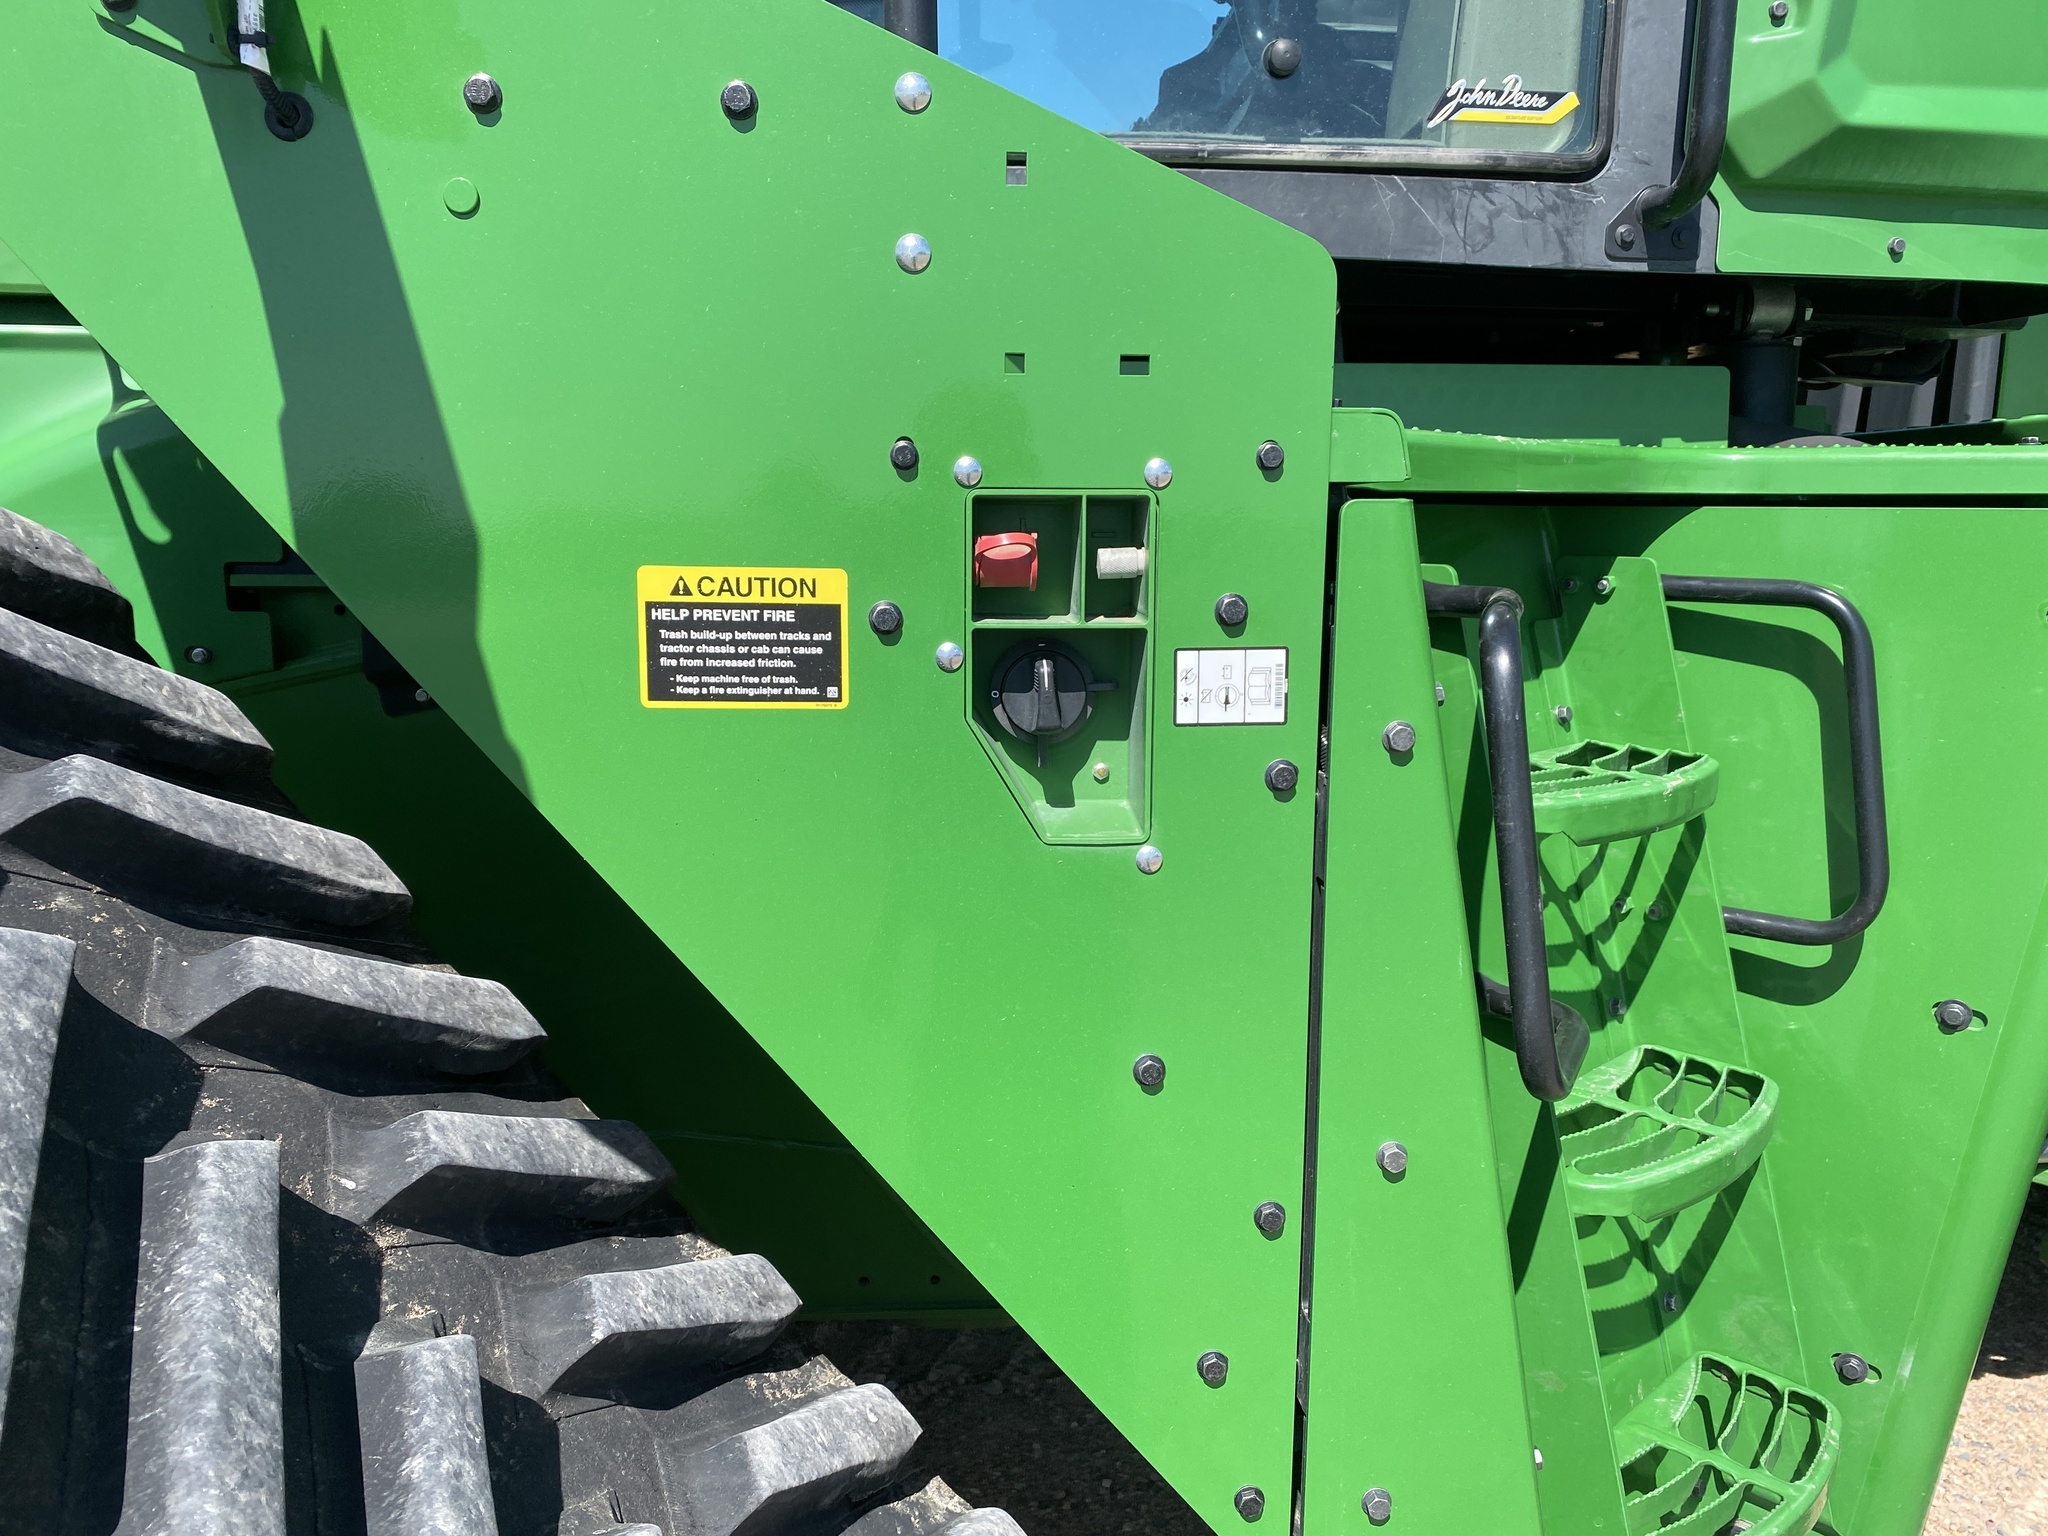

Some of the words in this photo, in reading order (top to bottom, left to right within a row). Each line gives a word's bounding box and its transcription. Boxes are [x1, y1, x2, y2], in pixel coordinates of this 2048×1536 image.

[1426, 78, 1498, 129] John
[1494, 74, 1549, 109] Deere
[697, 576, 816, 598] CAUTION
[651, 608, 690, 621] HELP
[693, 609, 761, 622] PREVENT
[763, 610, 796, 622] FIRE
[659, 629, 689, 640] Trash
[690, 630, 733, 642] build-up
[735, 631, 778, 641] between
[779, 631, 811, 641] tracks
[813, 632, 832, 641] and
[660, 644, 695, 654] tractor
[696, 644, 736, 654] chassis
[738, 646, 750, 654] or
[751, 645, 771, 654] cab
[772, 646, 791, 655] can
[793, 647, 824, 655] cause
[660, 657, 678, 667] fire
[679, 657, 704, 667] from
[706, 658, 756, 668] increased
[757, 658, 797, 668] friction.
[676, 674, 701, 685] Keep
[701, 675, 740, 684] machine
[741, 675, 760, 684] free
[761, 675, 772, 684] of
[772, 675, 799, 684] trash.
[676, 686, 701, 696] Keep
[702, 687, 708, 695] a
[709, 686, 725, 695] fire
[726, 686, 783, 698] extinguisher
[784, 687, 794, 695] at
[795, 687, 820, 696] hand.
